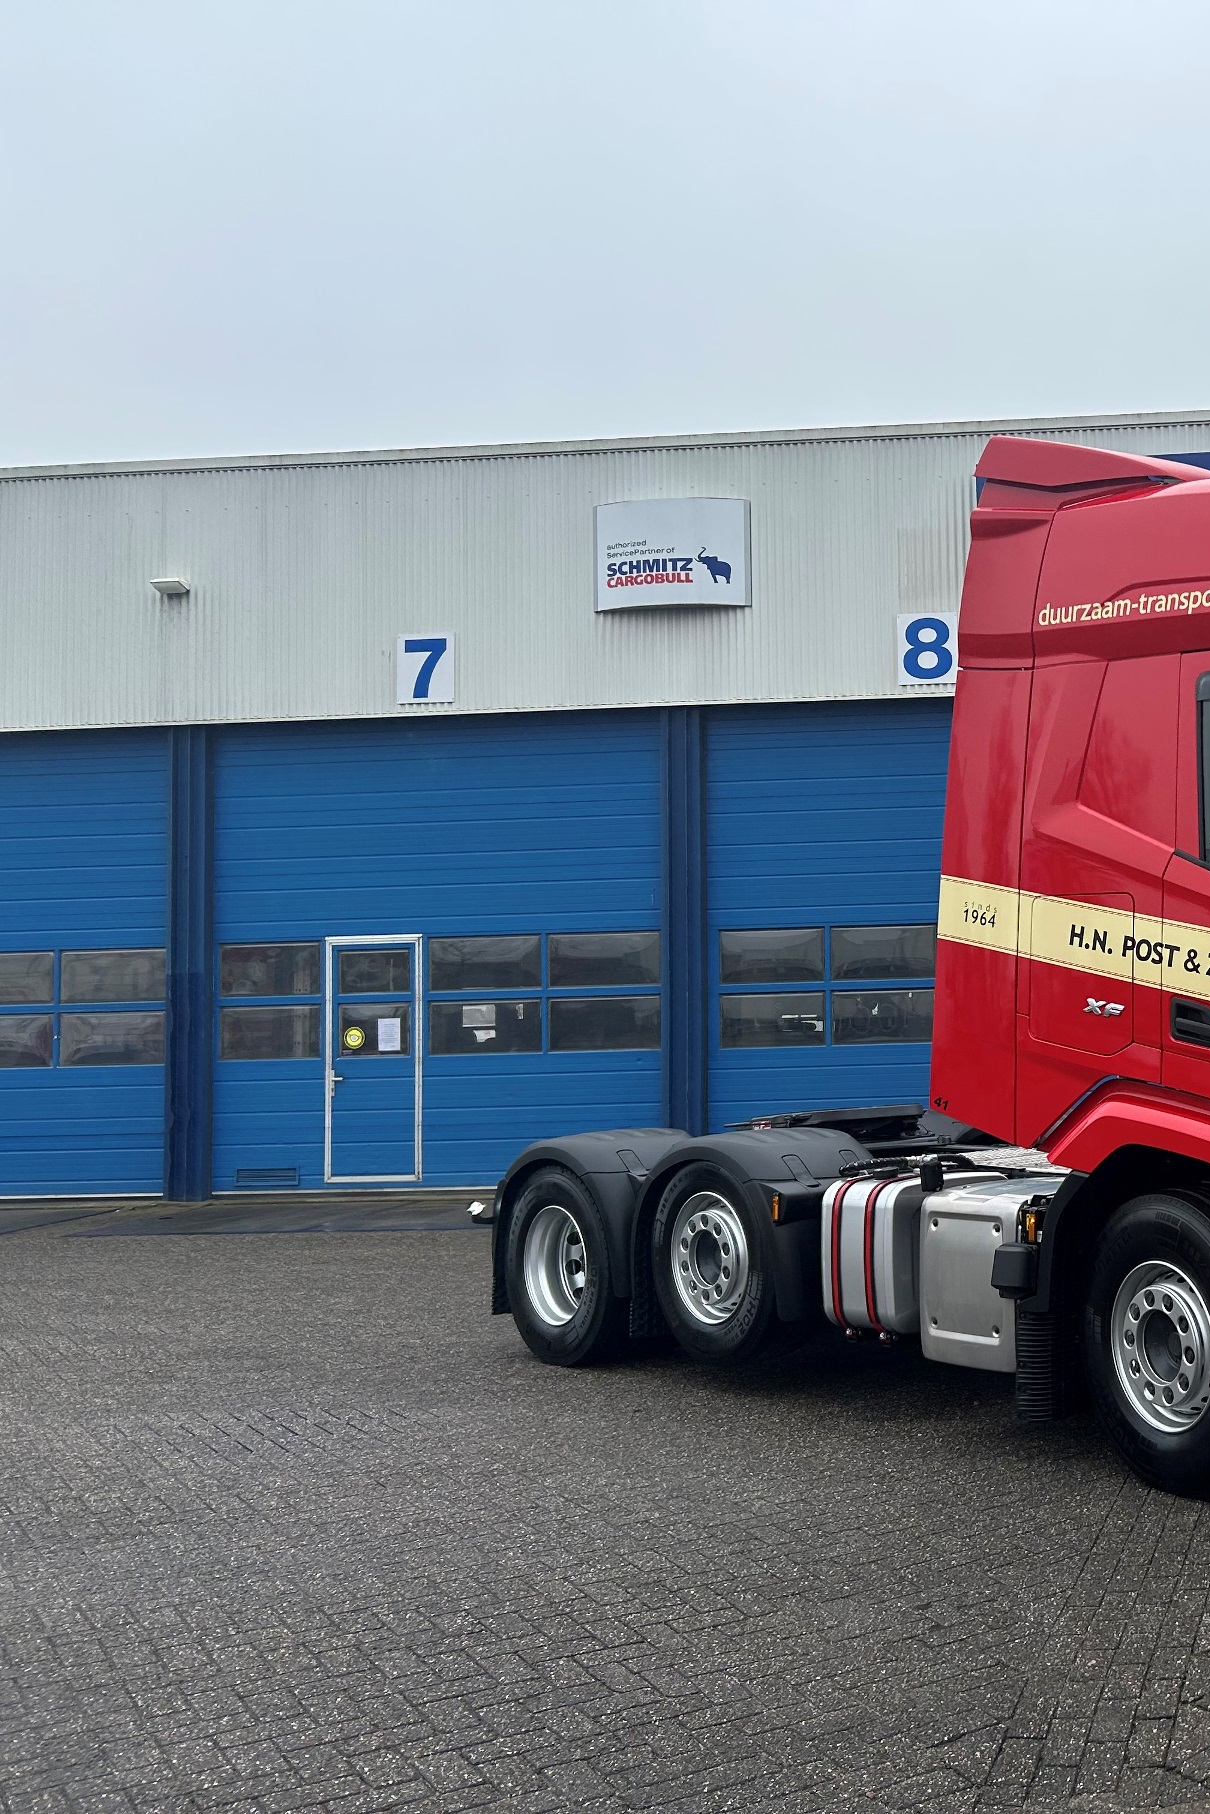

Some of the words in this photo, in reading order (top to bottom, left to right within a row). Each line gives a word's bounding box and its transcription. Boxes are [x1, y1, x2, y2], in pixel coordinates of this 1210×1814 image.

[606, 540, 647, 551] authorized
[606, 557, 694, 577] SCHMITZ
[606, 572, 694, 588] CARGOBULL
[903, 617, 953, 680] 8
[404, 638, 447, 698] 7
[963, 908, 997, 928] 1964
[1068, 923, 1113, 954] H.N.
[1121, 935, 1181, 968] POST
[1183, 948, 1201, 975] &
[1082, 997, 1126, 1018] XF
[933, 1096, 949, 1111] 41
